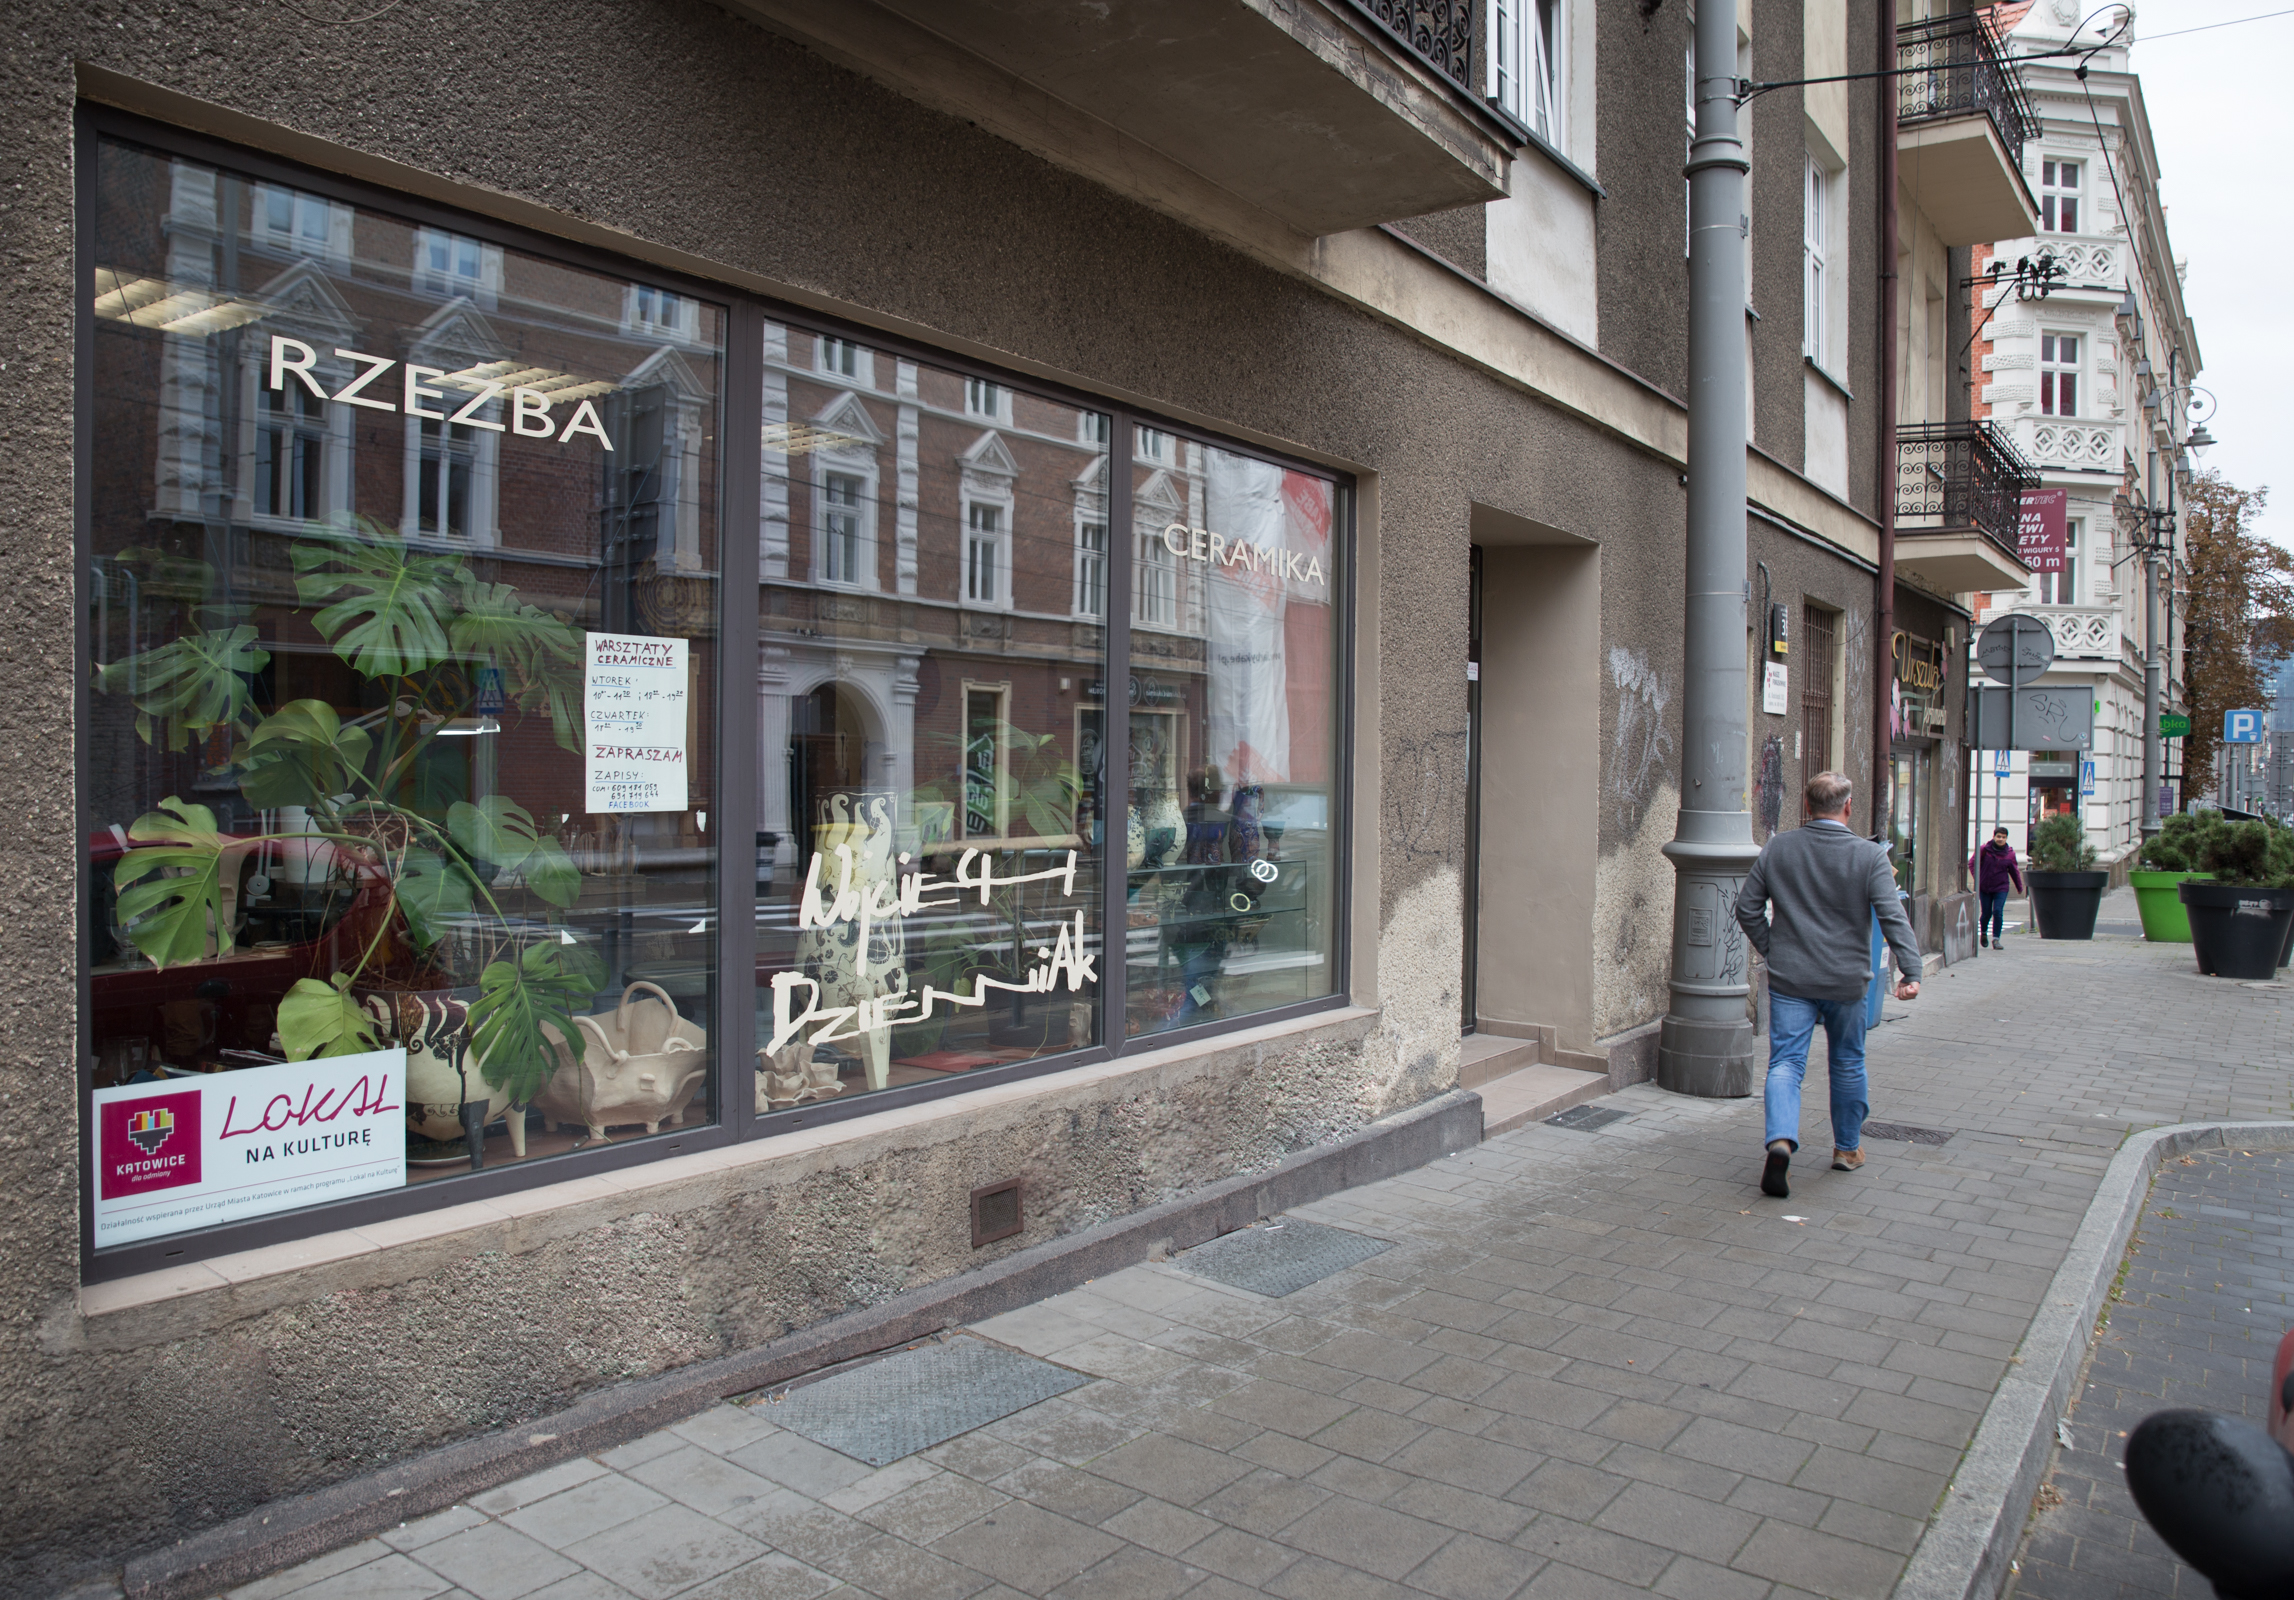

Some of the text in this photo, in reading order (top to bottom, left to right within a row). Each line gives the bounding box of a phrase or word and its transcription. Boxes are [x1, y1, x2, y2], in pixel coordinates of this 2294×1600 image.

[2020, 513, 2042, 523] NA
[2017, 523, 2045, 535] ZWI
[2018, 534, 2050, 546] ETY
[1163, 523, 1325, 586] CERAMIKA
[2023, 546, 2053, 554] WIGURY
[2046, 557, 2060, 567] m
[595, 639, 673, 656] WARSZTATY
[597, 654, 674, 667] CERAMICZNE
[1892, 631, 1939, 690] Urszula
[2159, 719, 2186, 729] bka
[2232, 713, 2254, 739] P
[595, 747, 682, 763] ZAPRASZAM
[611, 784, 627, 792] 609
[644, 783, 658, 791] 059
[608, 801, 650, 809] FACEBOOK
[219, 1073, 400, 1140] LOKAL
[246, 1128, 371, 1164] NA KULTURĘ
[116, 1154, 186, 1176] KATOWICE
[131, 1170, 172, 1182] dla odmiany
[101, 1216, 144, 1230] Działalność
[146, 1209, 183, 1222] wspierana
[184, 1205, 204, 1216] przez
[205, 1200, 226, 1210] Urząd
[227, 1195, 251, 1205] Miasta
[252, 1190, 283, 1200] Katowice
[290, 1183, 315, 1193] ramach
[315, 1178, 346, 1190] programu
